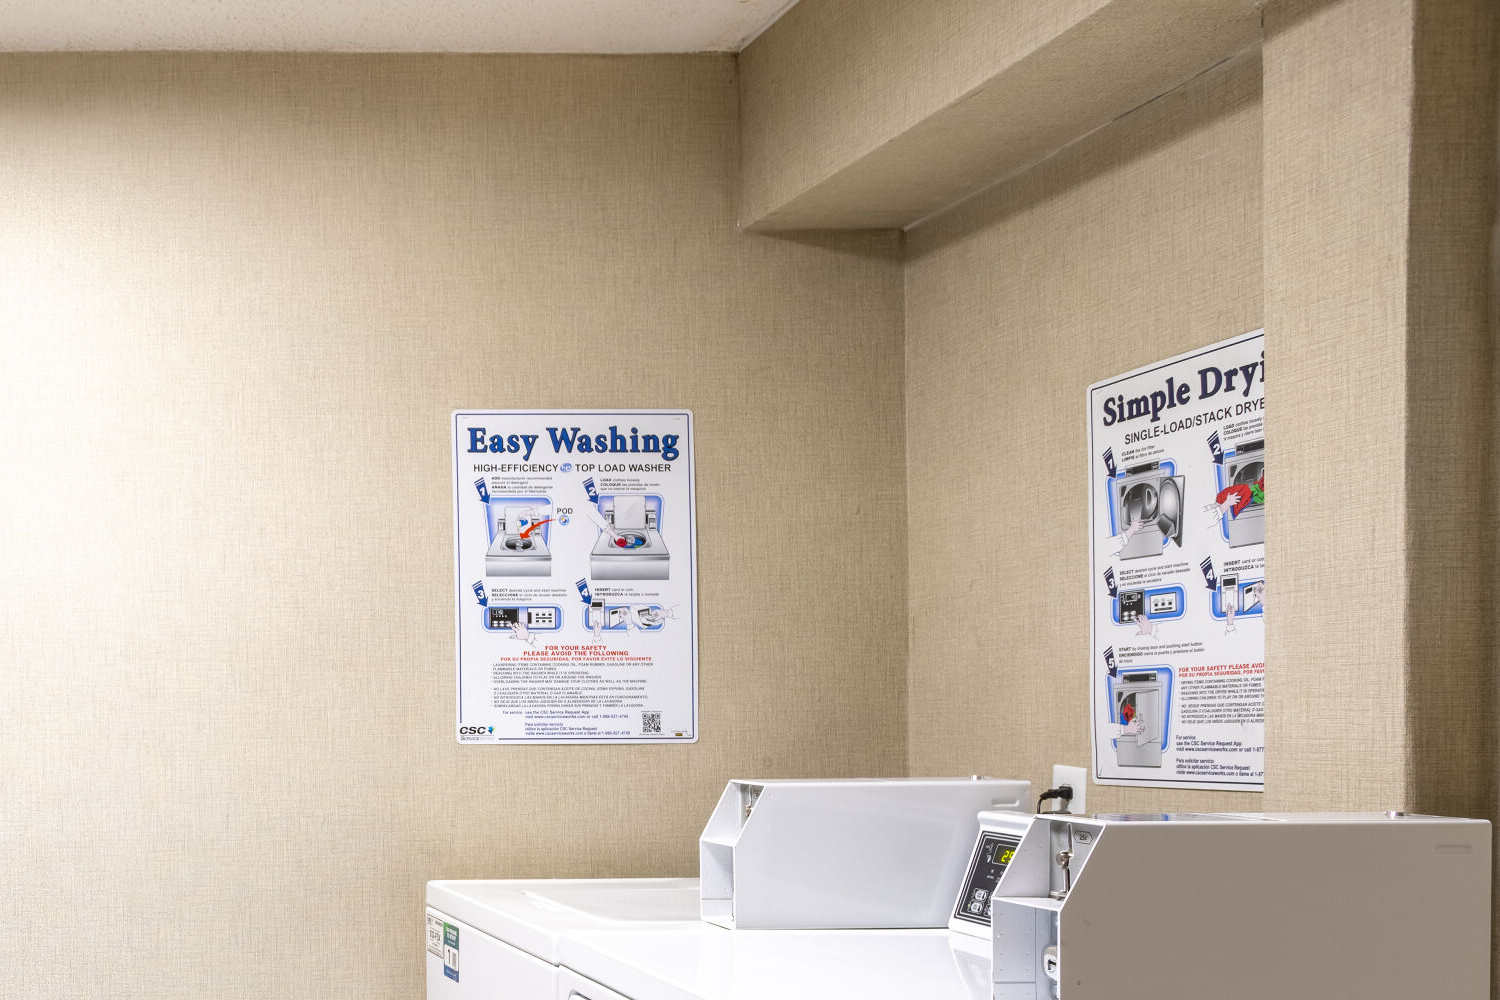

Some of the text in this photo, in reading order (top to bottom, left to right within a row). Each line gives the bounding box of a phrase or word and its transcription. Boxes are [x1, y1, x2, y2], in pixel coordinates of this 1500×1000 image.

[1102, 376, 1191, 427] Simple
[1124, 406, 1233, 445] SINGLE-LOAD/STACK
[467, 425, 680, 461] Easy Washing
[1213, 443, 1221, 456] 2
[473, 463, 558, 472] HIGH-EFFICIENCY
[575, 463, 596, 472] TOP
[598, 463, 626, 472] LOAD
[628, 463, 671, 472] WASHER
[1107, 459, 1113, 470] 1
[479, 486, 486, 495] 1
[588, 486, 596, 496] 2
[1205, 568, 1214, 580] 4
[1108, 578, 1115, 589] 3
[477, 590, 485, 599] 3
[581, 588, 589, 597] 4
[1108, 657, 1115, 669] 5
[459, 726, 487, 735] CSC
